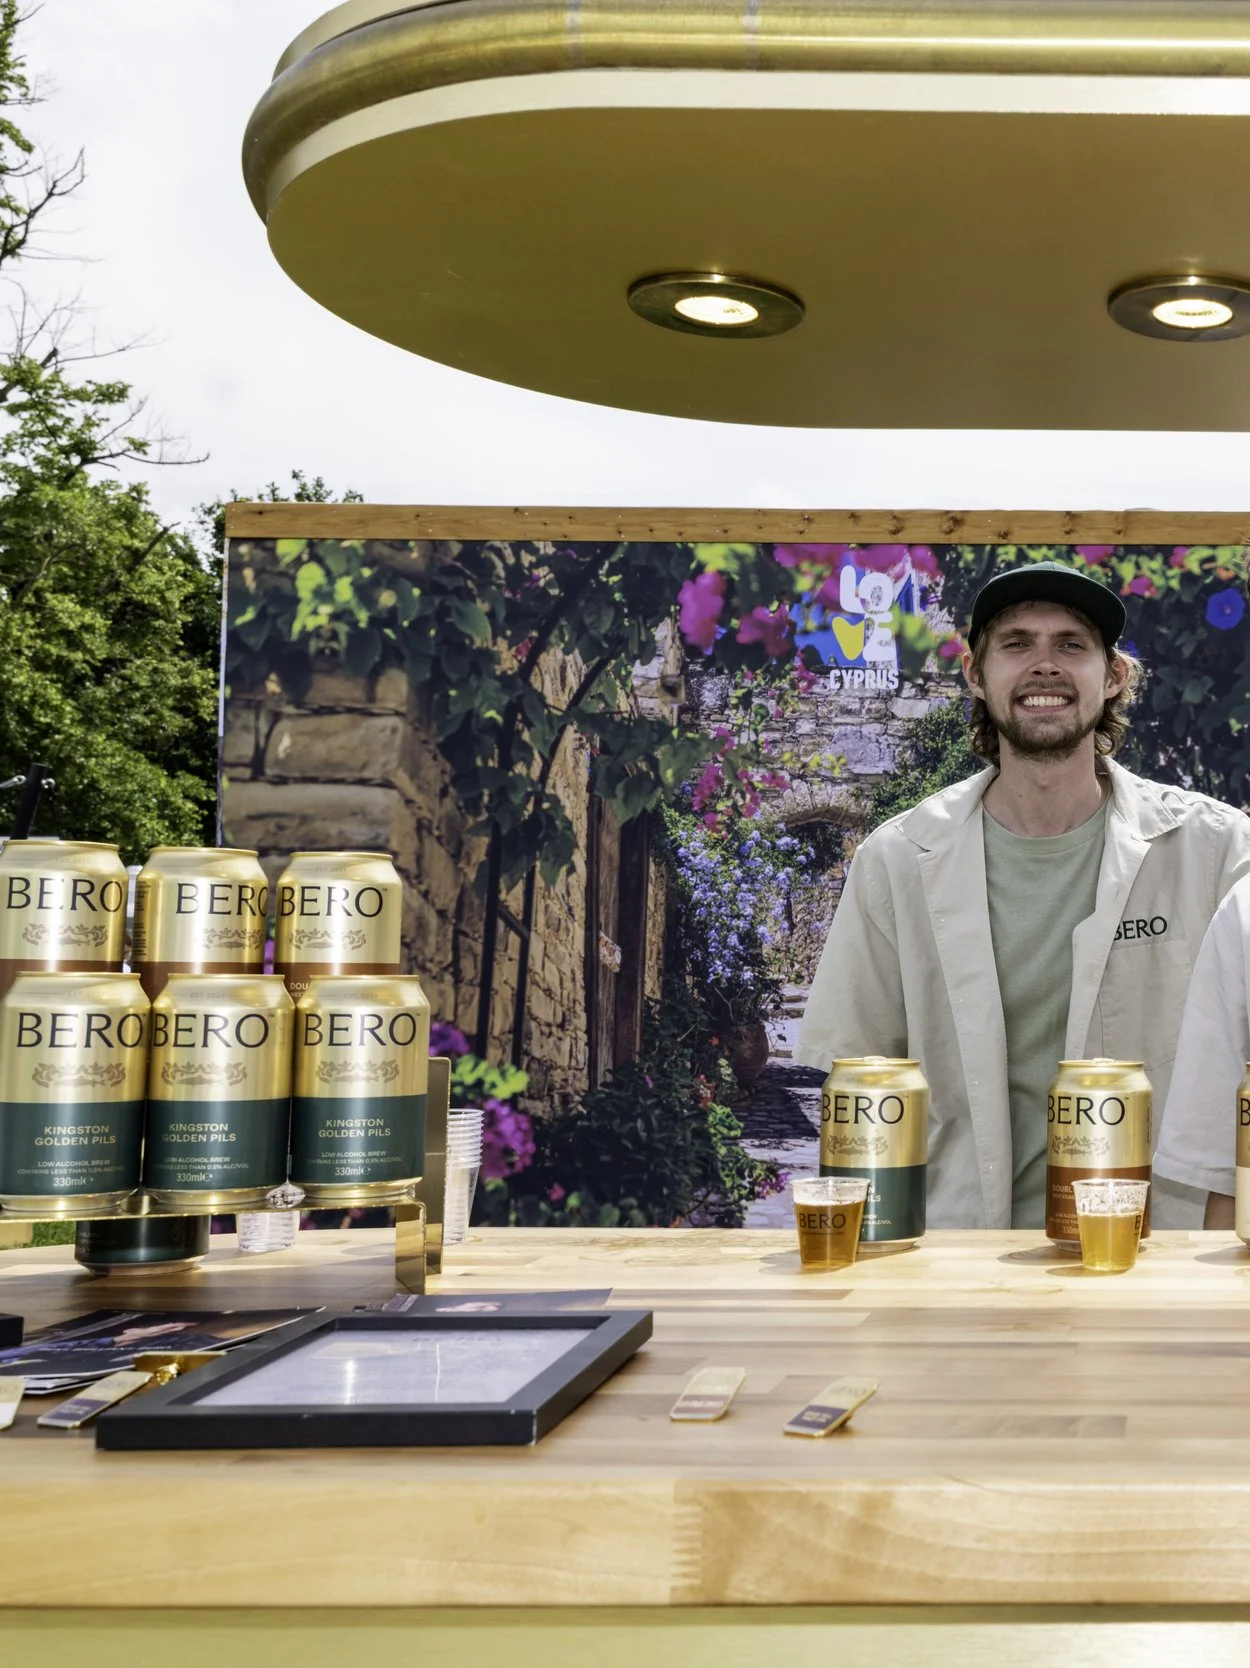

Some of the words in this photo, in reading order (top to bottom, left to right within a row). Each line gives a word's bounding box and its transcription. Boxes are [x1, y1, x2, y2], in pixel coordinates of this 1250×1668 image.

[829, 669, 899, 690] CYPRUS
[7, 877, 123, 912] BERO
[280, 886, 384, 917] BERO
[17, 1012, 143, 1048] BERO
[153, 1013, 269, 1048] BERO
[304, 1013, 417, 1046] BERO
[822, 1094, 904, 1124] BERO
[44, 1125, 109, 1135] KINGSTON
[169, 1123, 229, 1132] KINGSTON
[326, 1118, 384, 1128] KINGSTON
[34, 1137, 88, 1146] GOLDEN
[92, 1135, 116, 1145] PILS
[162, 1134, 207, 1143] GOLDEN
[210, 1133, 237, 1142] PILS
[318, 1129, 365, 1138] GOLDEN
[368, 1128, 392, 1137] PILS
[55, 1160, 89, 1168] ALCOHOL
